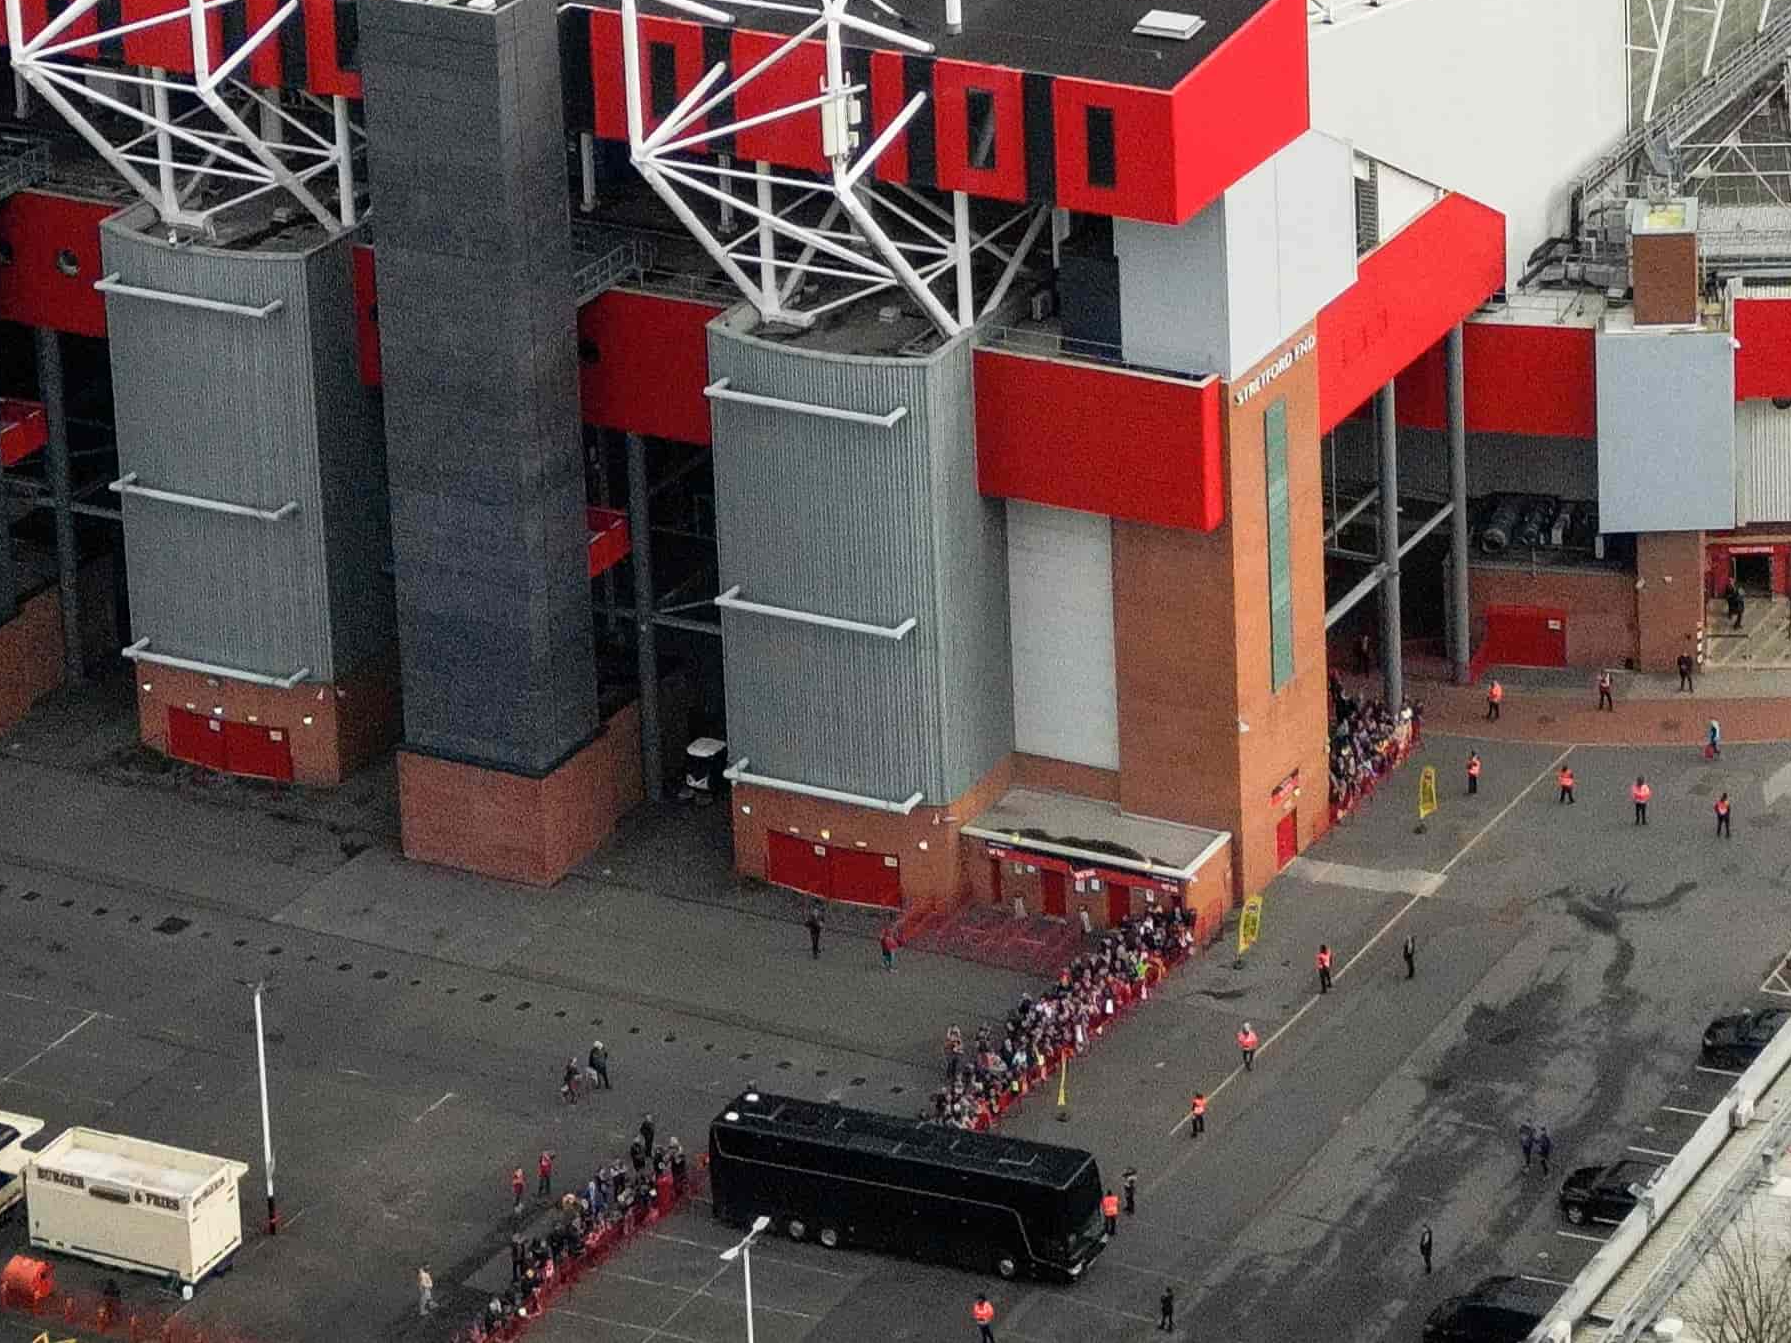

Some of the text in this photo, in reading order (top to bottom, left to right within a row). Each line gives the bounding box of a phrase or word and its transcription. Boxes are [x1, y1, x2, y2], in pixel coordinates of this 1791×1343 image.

[1234, 335, 1316, 407] STRETFORD END
[37, 1166, 85, 1190] BURGER
[145, 1193, 181, 1212] FRIES
